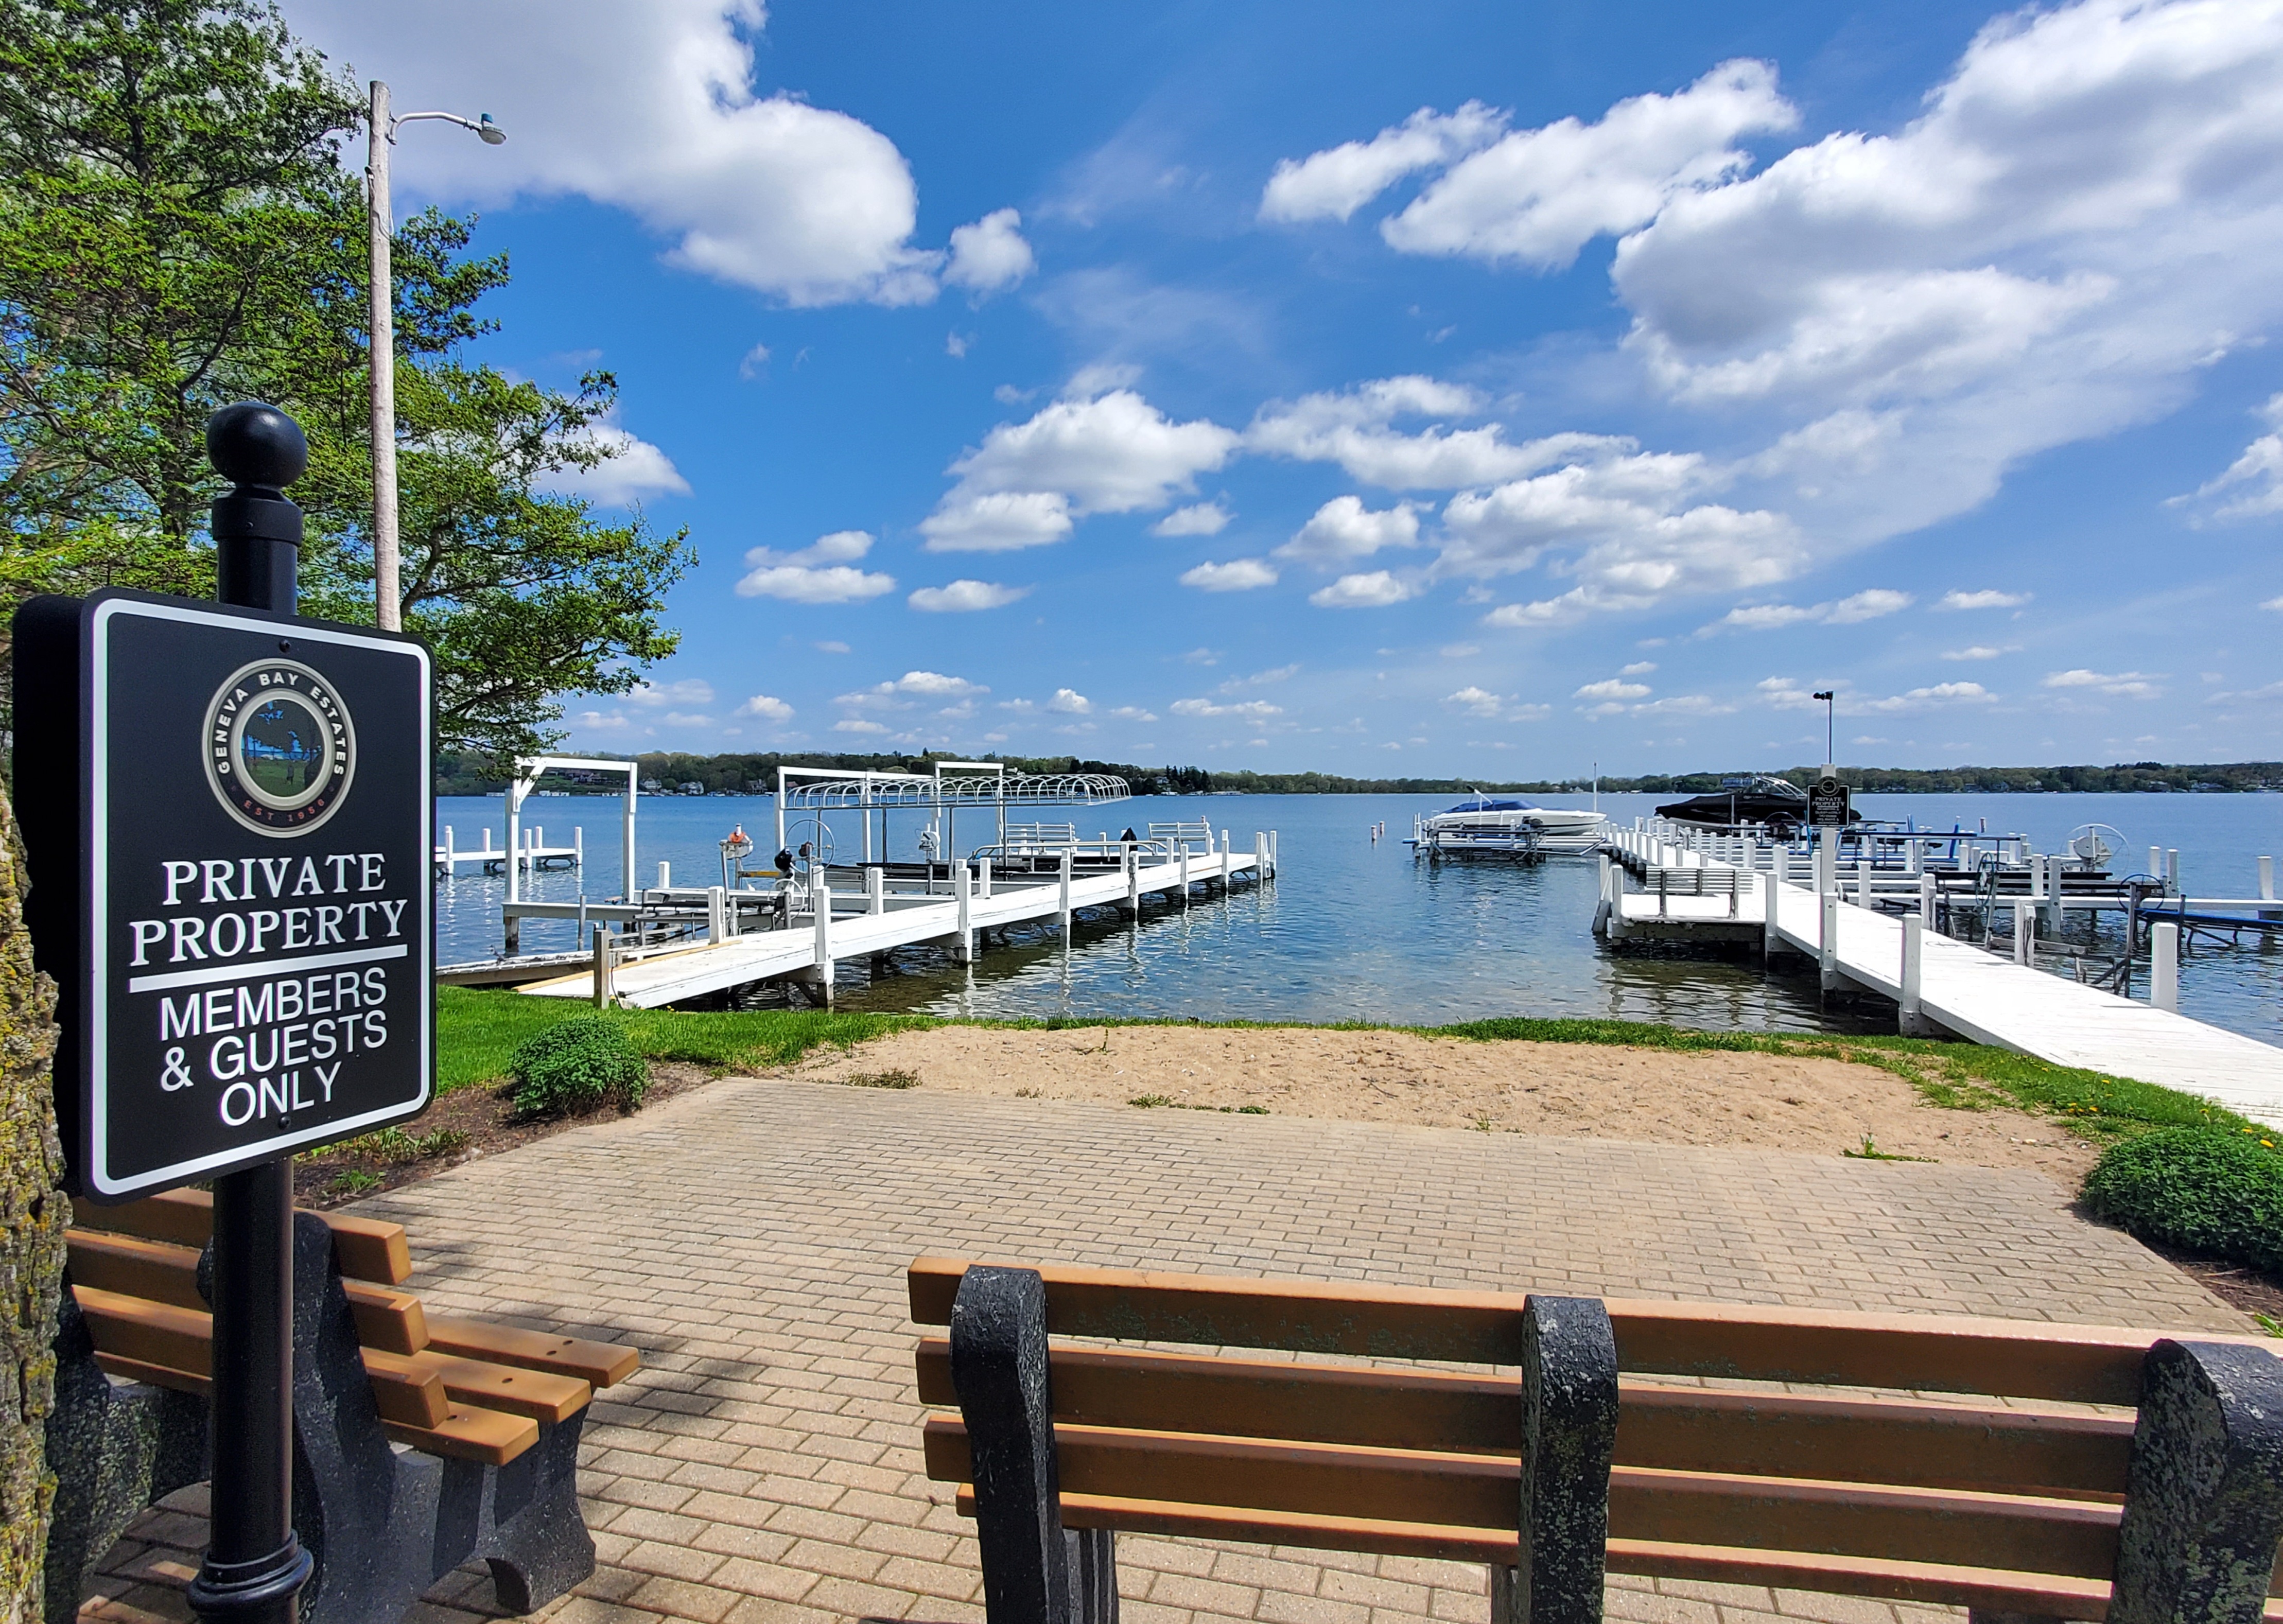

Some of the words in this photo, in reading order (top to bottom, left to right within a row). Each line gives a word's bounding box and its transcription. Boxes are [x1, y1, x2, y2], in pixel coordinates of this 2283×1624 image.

[215, 688, 249, 774] GENEVA
[259, 672, 299, 686] BAY
[310, 686, 346, 775] ESTATES
[239, 799, 274, 821] EST
[161, 852, 386, 906] PRIVATE
[129, 899, 408, 967] PROPERTY
[160, 967, 387, 1041] MEMBERS
[160, 1046, 194, 1092] &
[209, 1009, 388, 1080] GUESTS
[219, 1061, 342, 1127] ONLY
